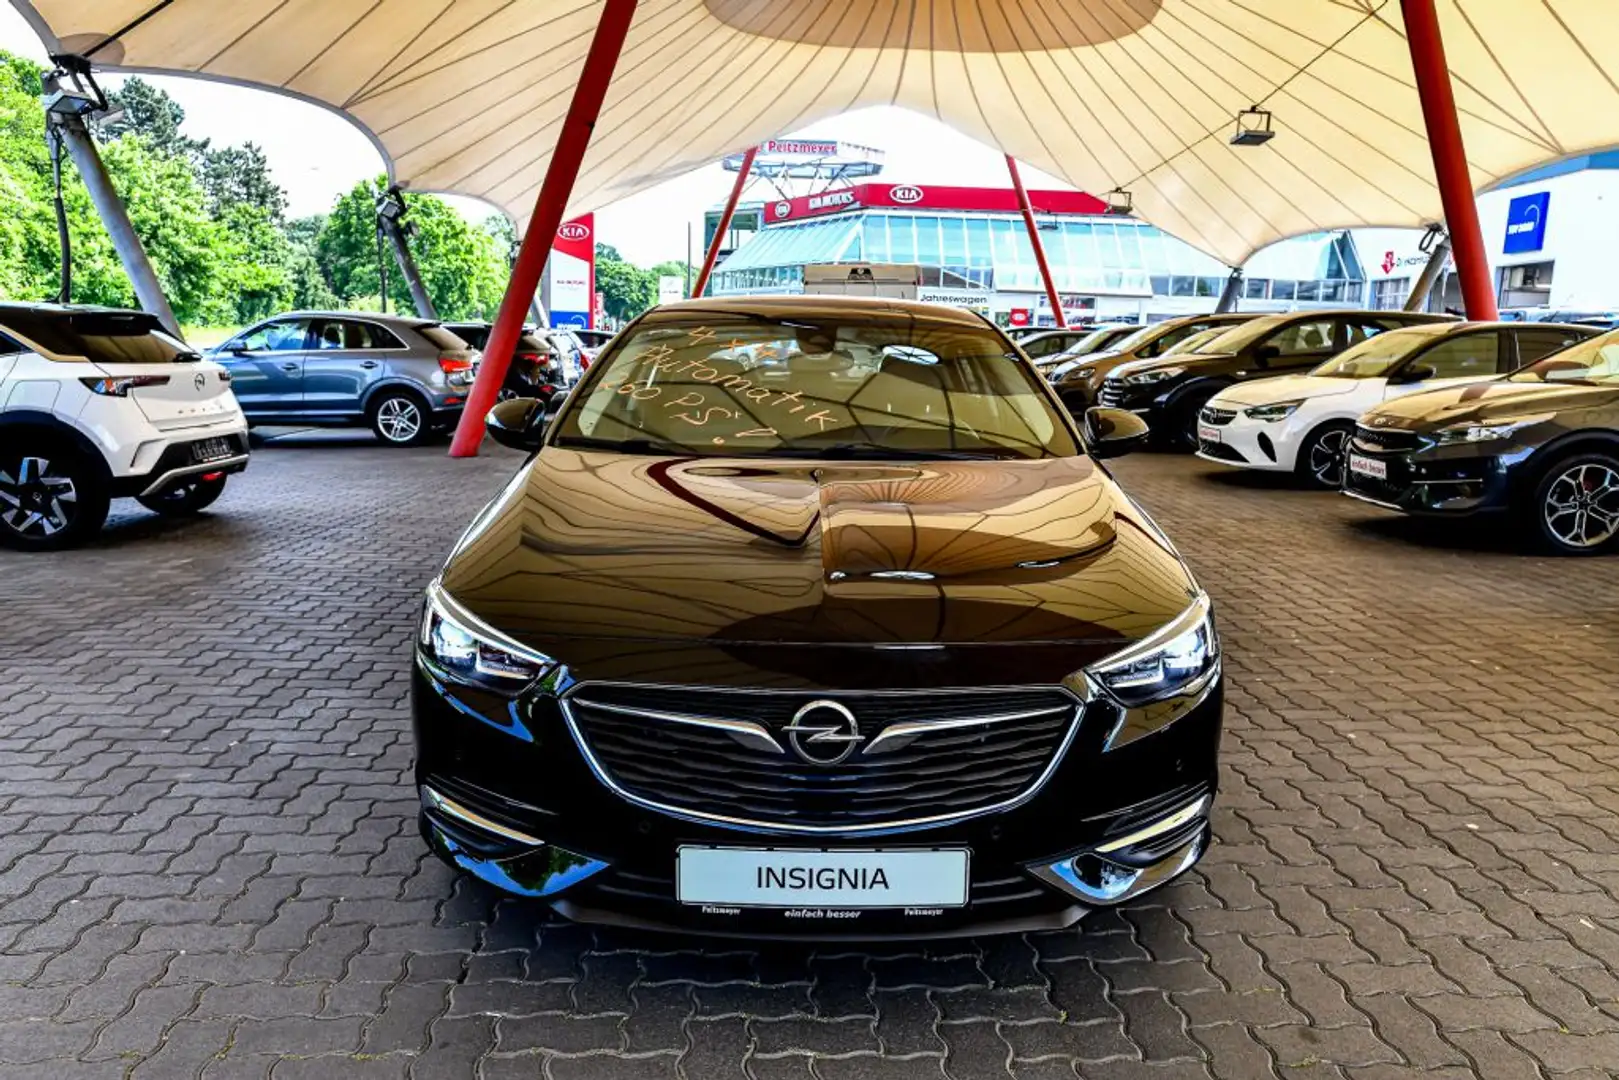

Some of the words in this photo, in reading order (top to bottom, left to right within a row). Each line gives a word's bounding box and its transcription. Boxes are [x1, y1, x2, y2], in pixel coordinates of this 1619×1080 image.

[768, 140, 838, 154] Peitzmeyer
[895, 188, 918, 200] KIA
[562, 227, 584, 237] KIA
[920, 293, 988, 305] Jahreswagen
[633, 343, 838, 431] Automatik
[756, 866, 890, 890] INSIGNIA
[784, 908, 824, 918] einfach
[826, 908, 861, 918] besser
